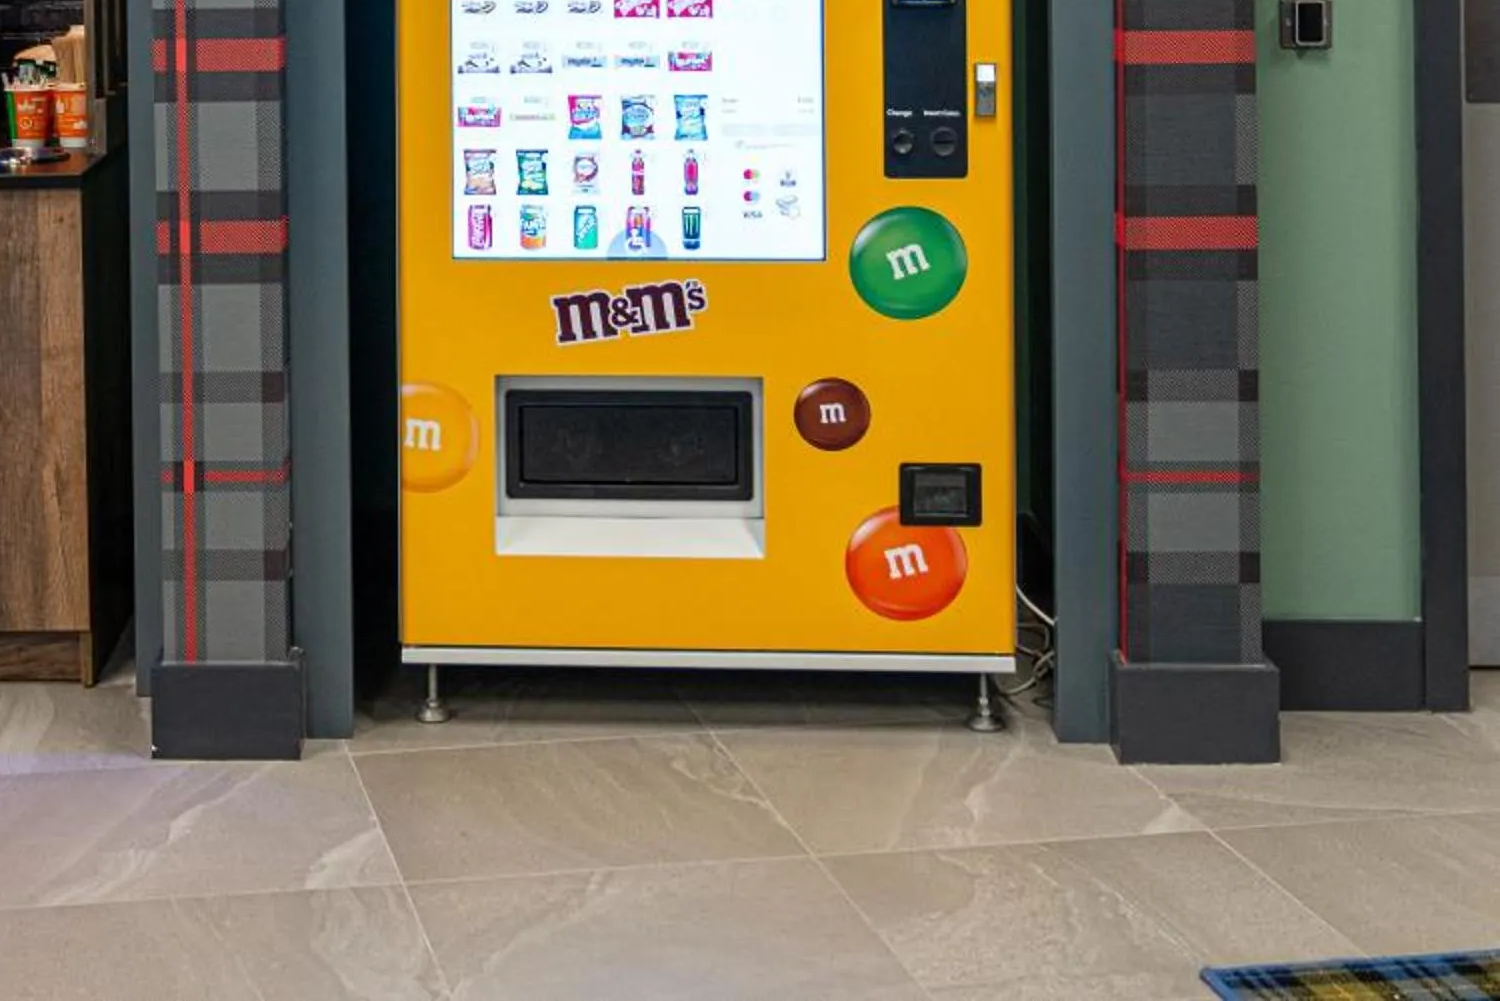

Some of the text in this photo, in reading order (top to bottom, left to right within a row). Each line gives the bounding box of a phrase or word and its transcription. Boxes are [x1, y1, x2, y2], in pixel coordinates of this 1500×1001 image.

[885, 243, 932, 280] m
[553, 279, 707, 343] m&m's
[820, 402, 847, 424] m
[403, 418, 442, 451] m
[884, 543, 929, 580] m
